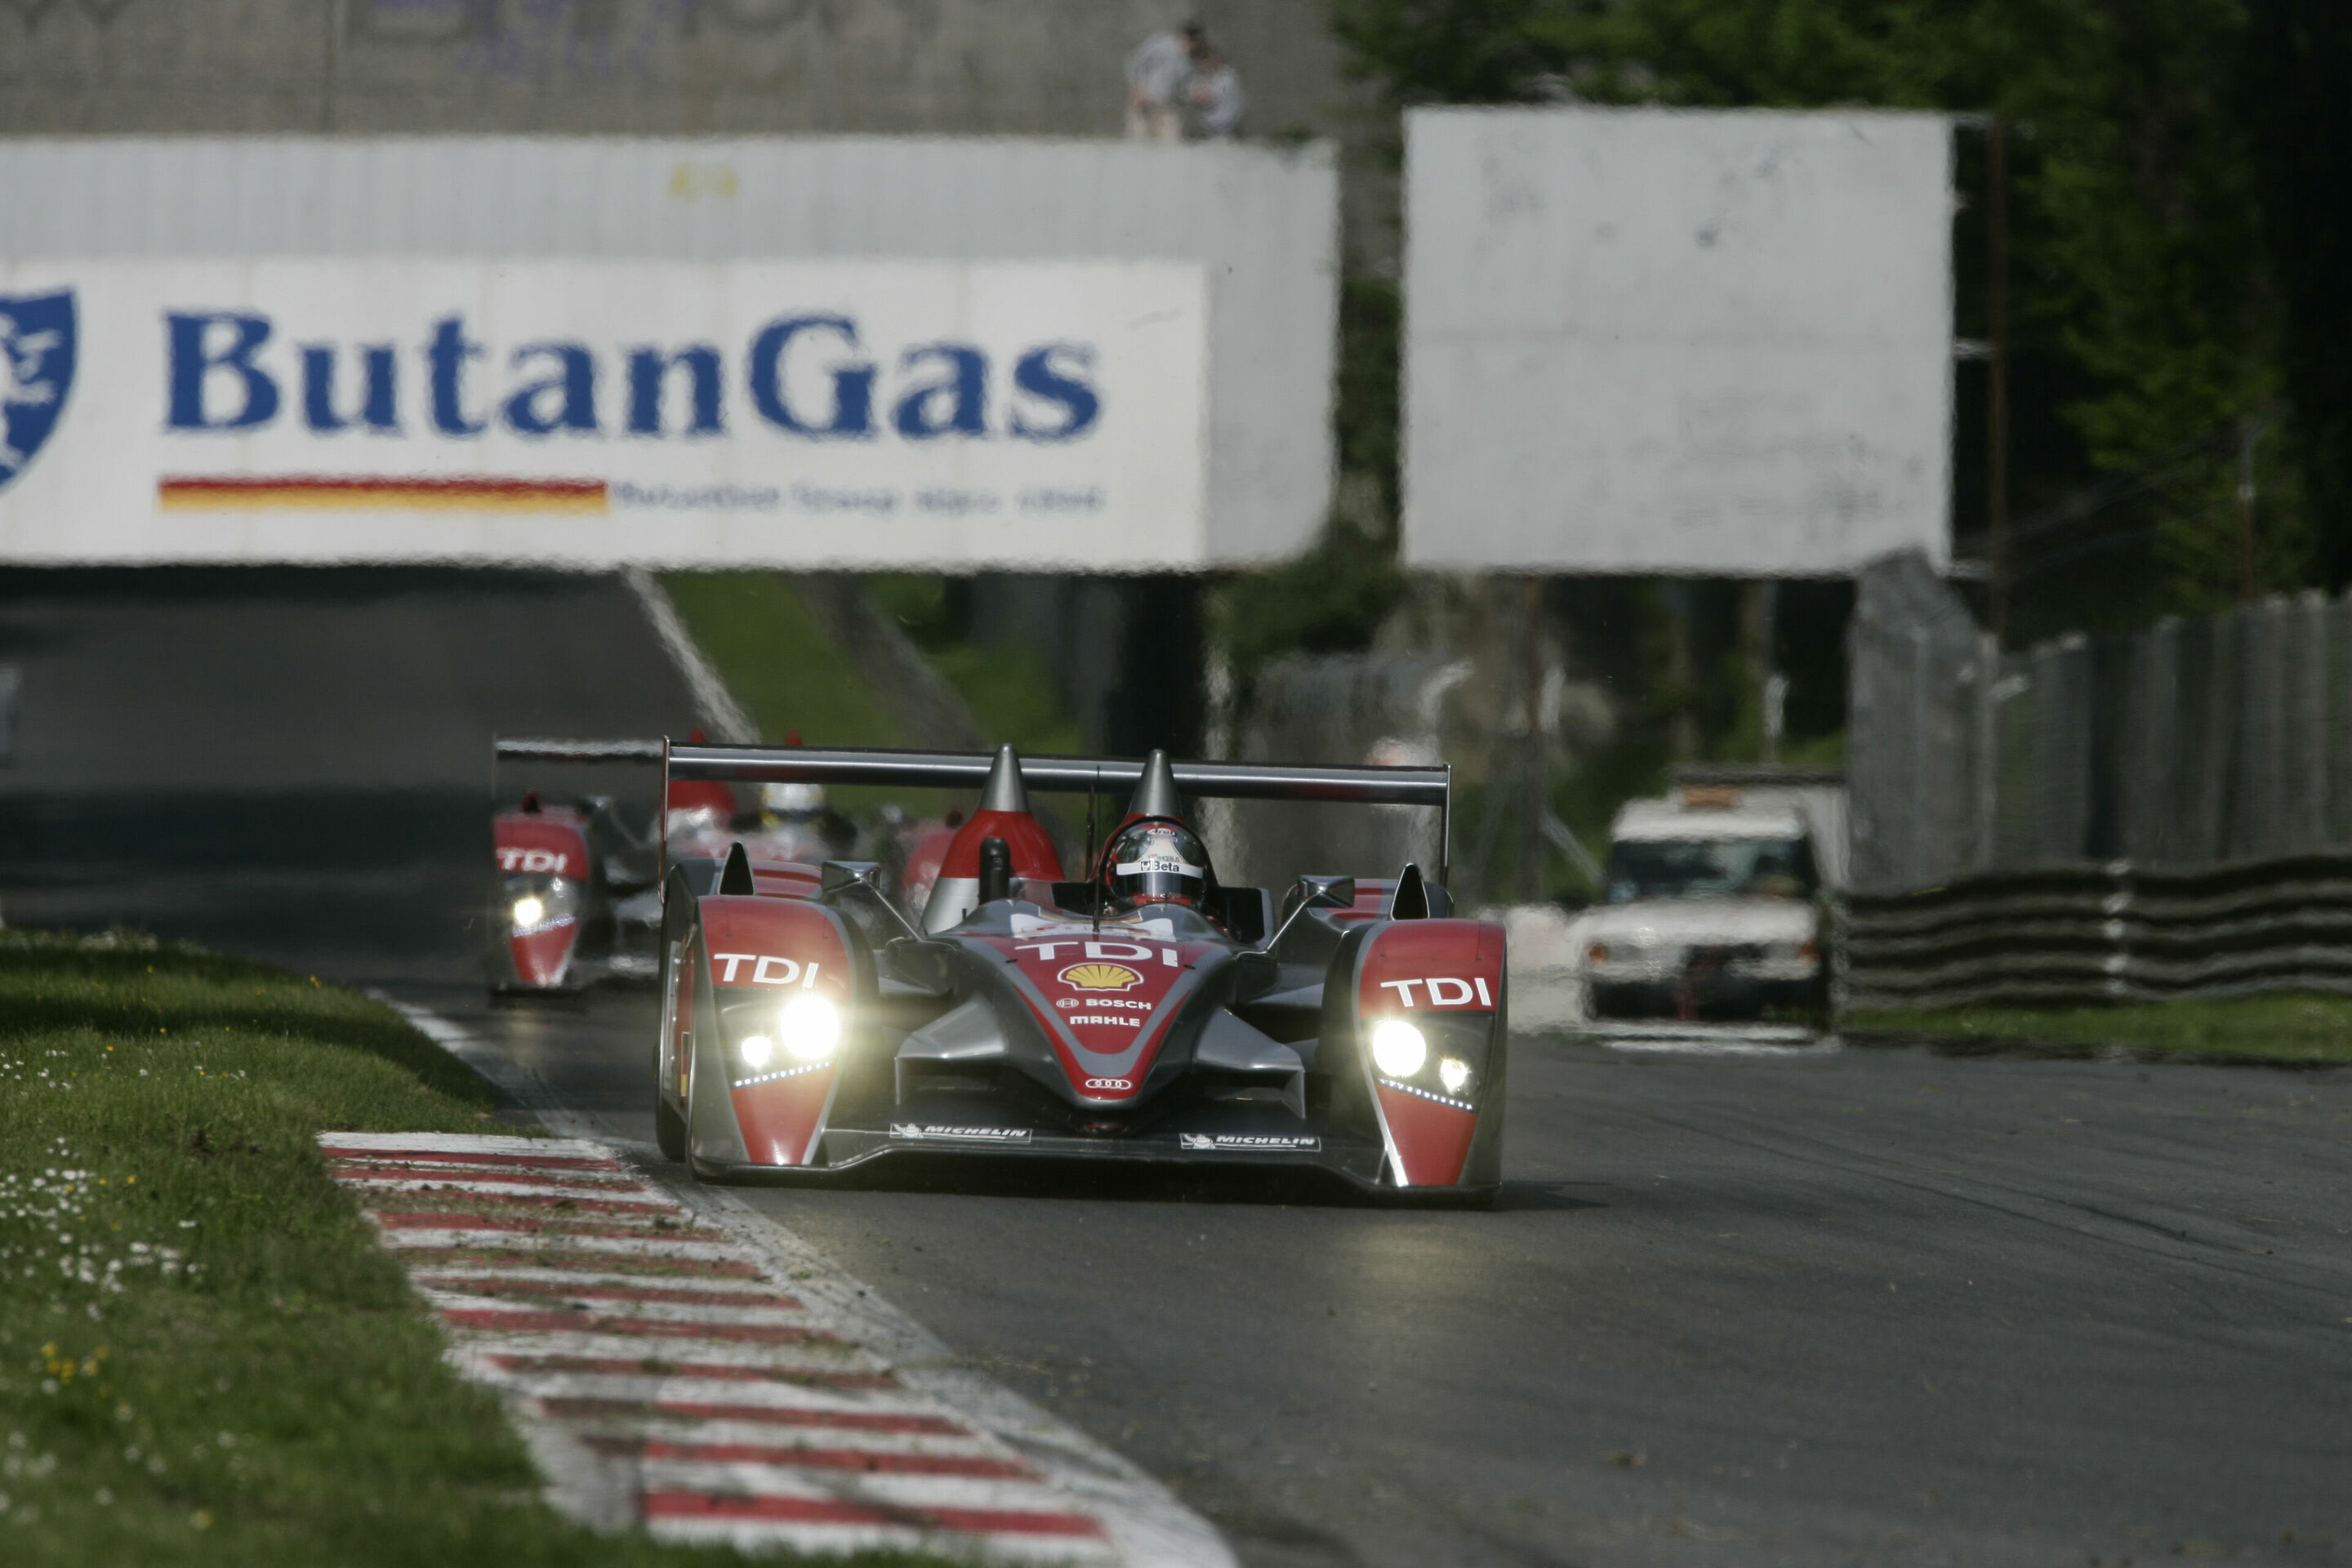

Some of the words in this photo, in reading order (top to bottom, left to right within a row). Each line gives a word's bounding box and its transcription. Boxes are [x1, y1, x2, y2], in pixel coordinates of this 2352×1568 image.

[163, 308, 1101, 442] ButanGas
[496, 847, 568, 873] TDI
[1154, 861, 1179, 872] Beta
[1014, 941, 1178, 967] TDI
[713, 953, 819, 989] TDI
[1380, 978, 1491, 1008] TDI
[1085, 998, 1152, 1010] BOSCH
[1070, 1016, 1141, 1027] MAHLE
[924, 1125, 1027, 1137] MICHELIN
[1216, 1135, 1316, 1145] MICHELIN
